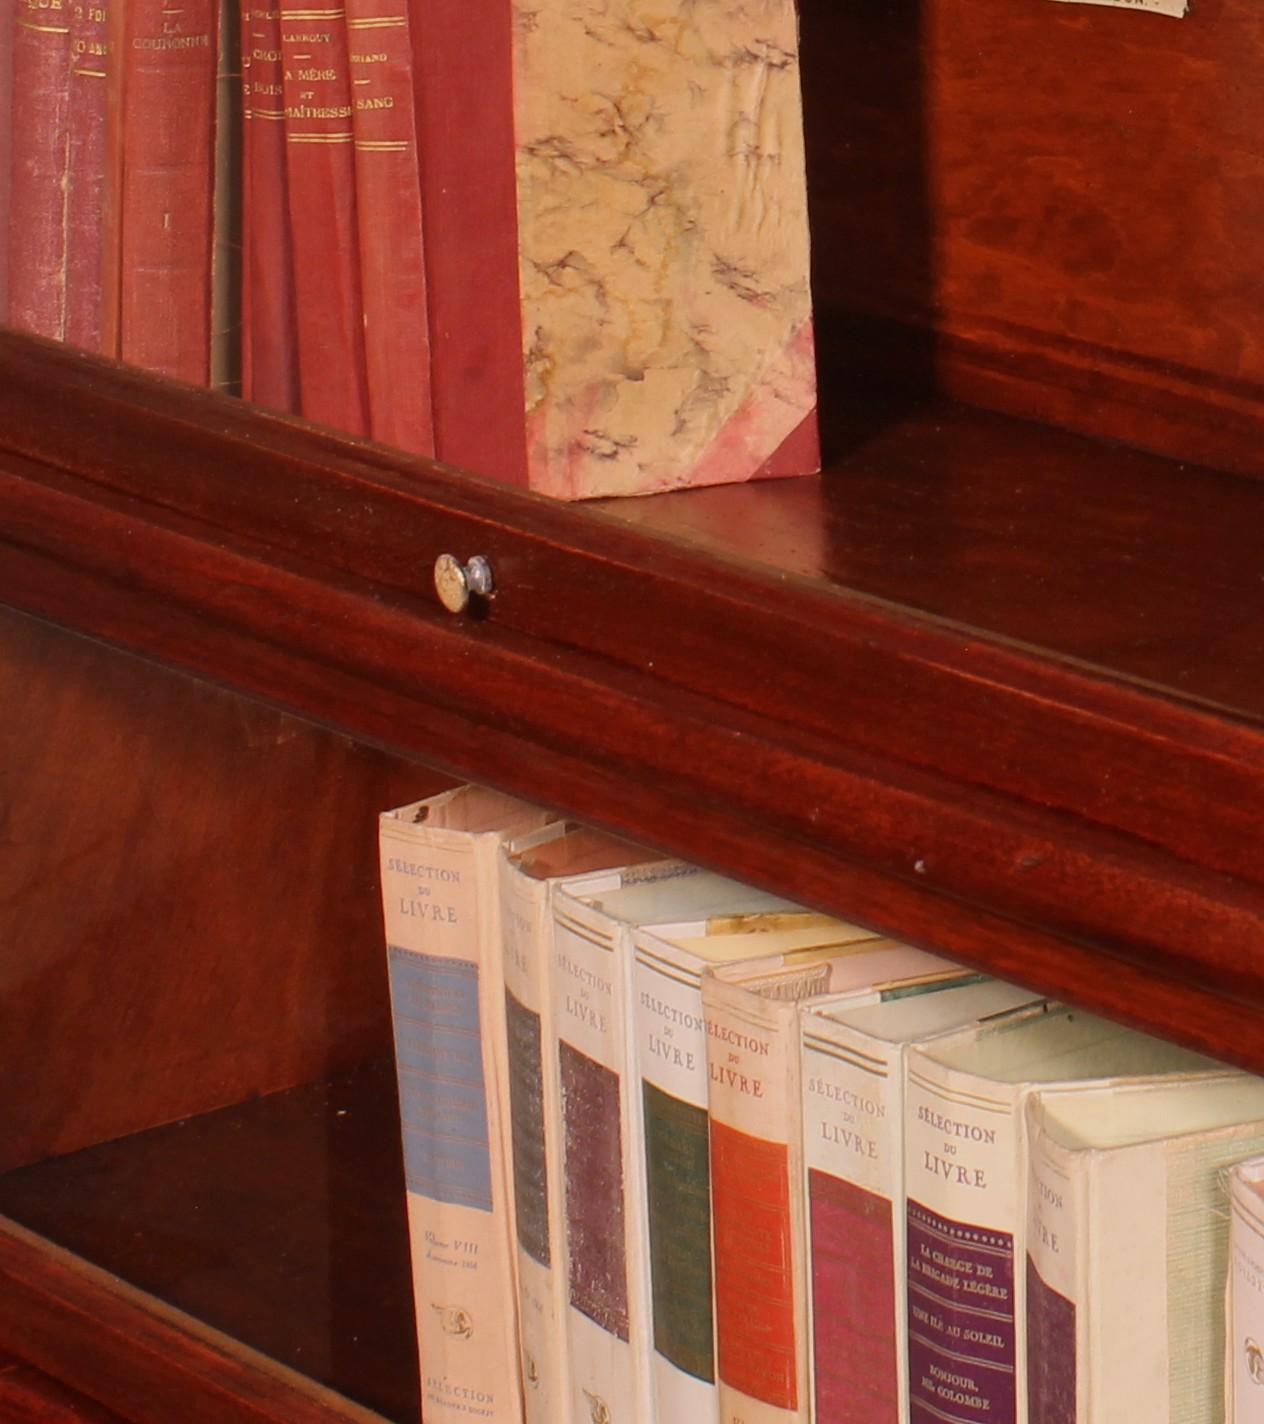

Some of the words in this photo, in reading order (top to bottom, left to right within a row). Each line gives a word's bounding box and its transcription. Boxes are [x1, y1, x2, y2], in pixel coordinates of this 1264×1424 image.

[356, 96, 394, 110] SANG
[400, 897, 457, 924] LIVRE
[566, 995, 607, 1033] LIVRE
[649, 1034, 695, 1072] LIVRE
[709, 1063, 764, 1099] LIVRE
[808, 1077, 886, 1119] SÉLECTION
[821, 1121, 879, 1160] LIVRE
[918, 1105, 997, 1145] SÉLECTION
[943, 1142, 957, 1156] DU
[924, 1150, 988, 1190] LIVRE
[453, 1239, 478, 1255] VIII
[921, 1243, 931, 1259] LA
[932, 1250, 974, 1274] CHARGE
[976, 1263, 994, 1279] DE
[921, 1263, 961, 1290] BRIGADE
[945, 1325, 961, 1337] AU
[963, 1328, 1006, 1349] SOLEIL
[929, 1364, 979, 1393] BONJOUR,
[937, 1385, 991, 1411] COLOMBE
